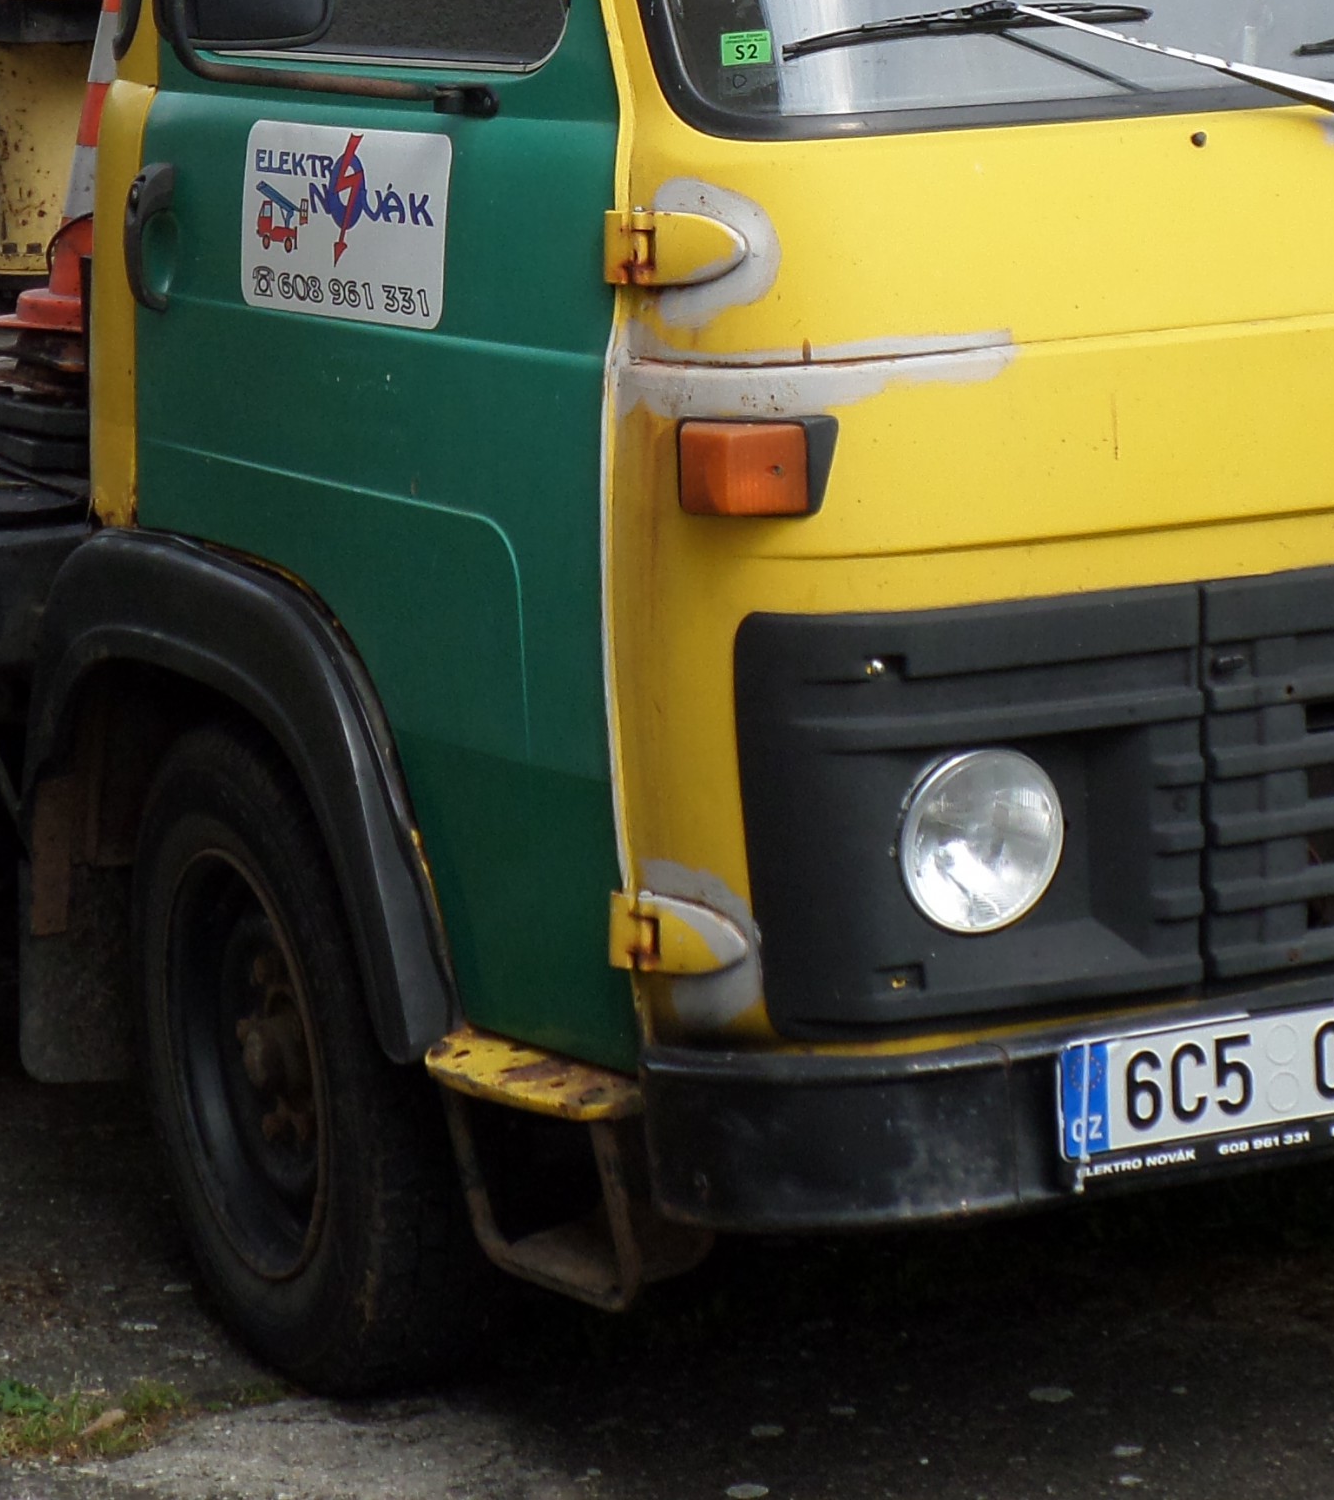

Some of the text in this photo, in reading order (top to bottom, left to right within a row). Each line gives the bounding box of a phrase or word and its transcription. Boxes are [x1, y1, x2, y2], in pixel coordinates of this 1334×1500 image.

[735, 44, 758, 60] S2
[278, 272, 430, 317] 608 961 331
[1125, 1033, 1254, 1130] 6C5
[1071, 1115, 1103, 1143] CZ
[1145, 1150, 1196, 1168] NOVÁK
[1218, 1141, 1249, 1155] 608
[1253, 1137, 1280, 1150] 961
[1283, 1131, 1310, 1145] 331
